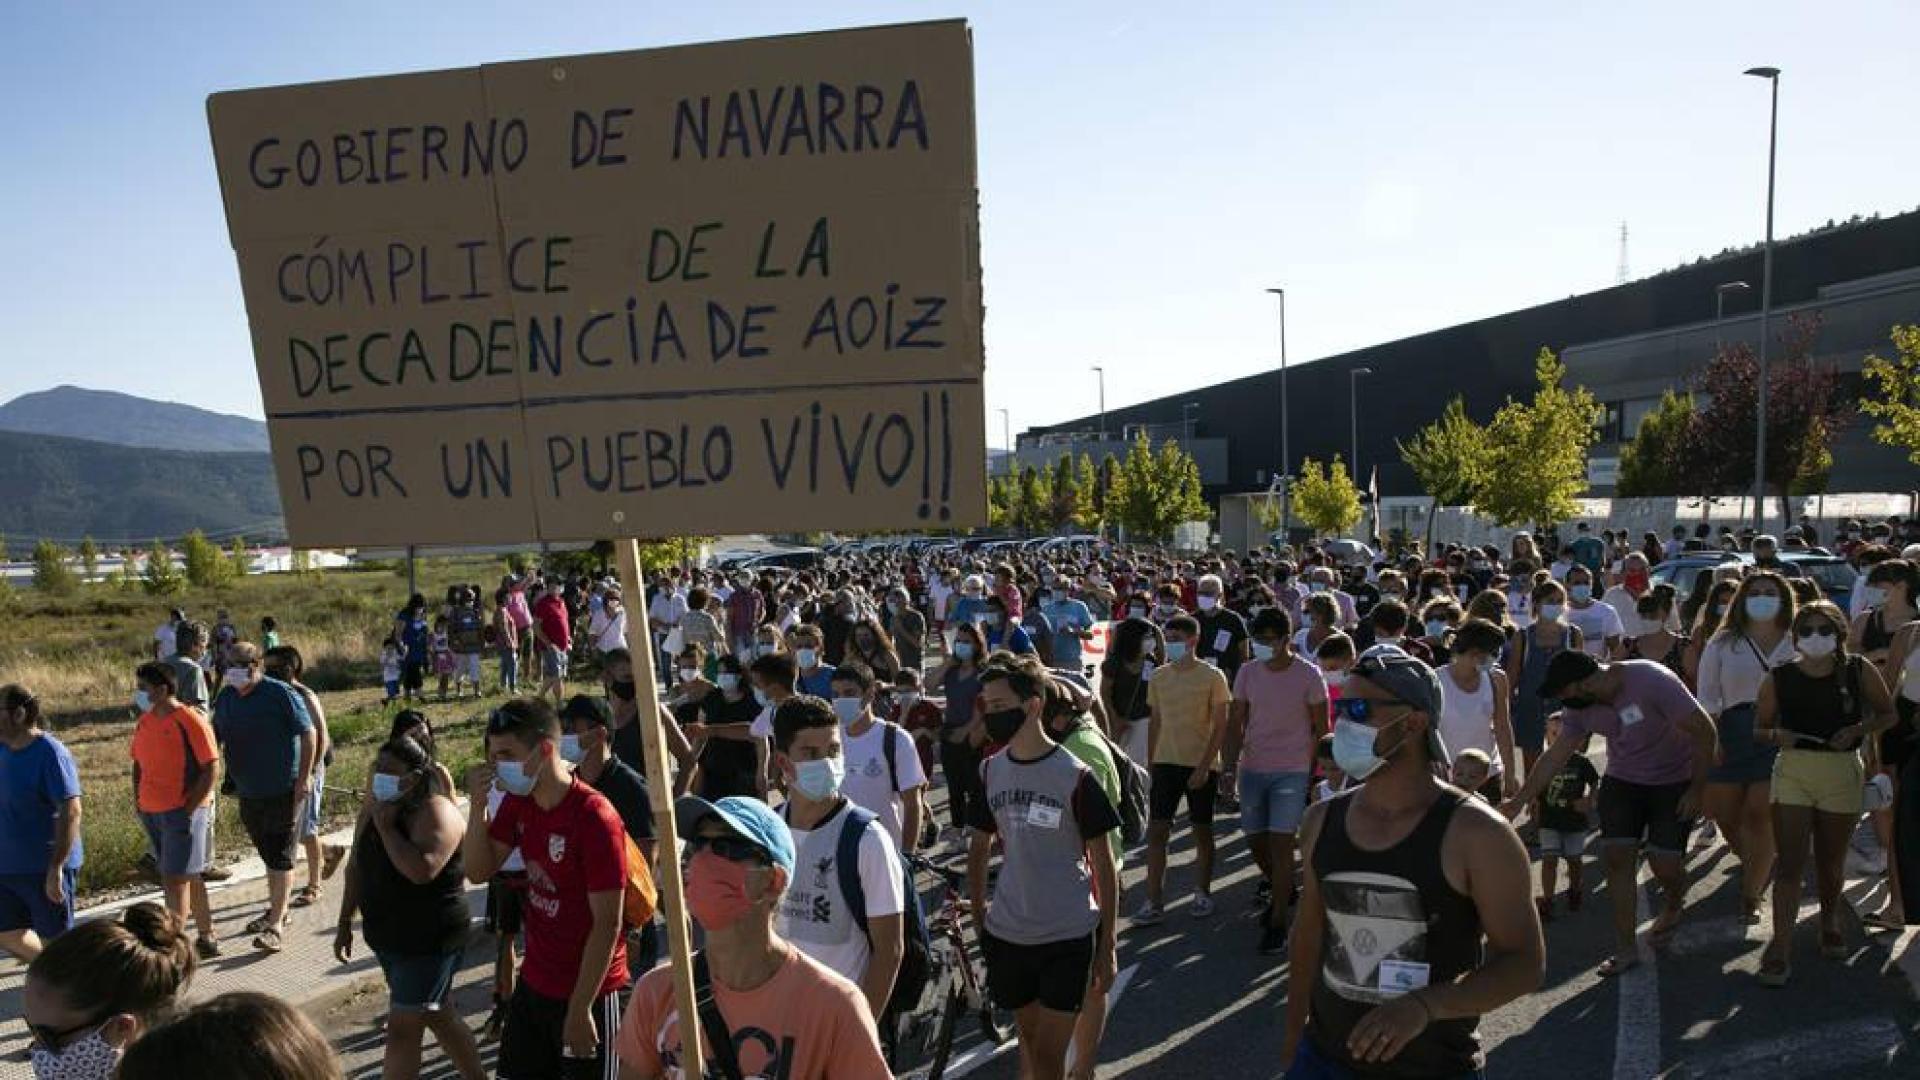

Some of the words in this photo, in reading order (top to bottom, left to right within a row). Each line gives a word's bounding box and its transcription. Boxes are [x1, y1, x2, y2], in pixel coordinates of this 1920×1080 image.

[249, 117, 529, 190] GOBIERNO
[570, 107, 635, 171] DE
[672, 78, 931, 161] NAVARRA
[276, 235, 574, 306] CÓMPLICE
[646, 220, 724, 284] DE
[754, 216, 831, 279] LA
[705, 300, 779, 364] DE
[296, 442, 408, 502] POR
[441, 437, 513, 500] UN
[546, 423, 734, 500] PUEBLO
